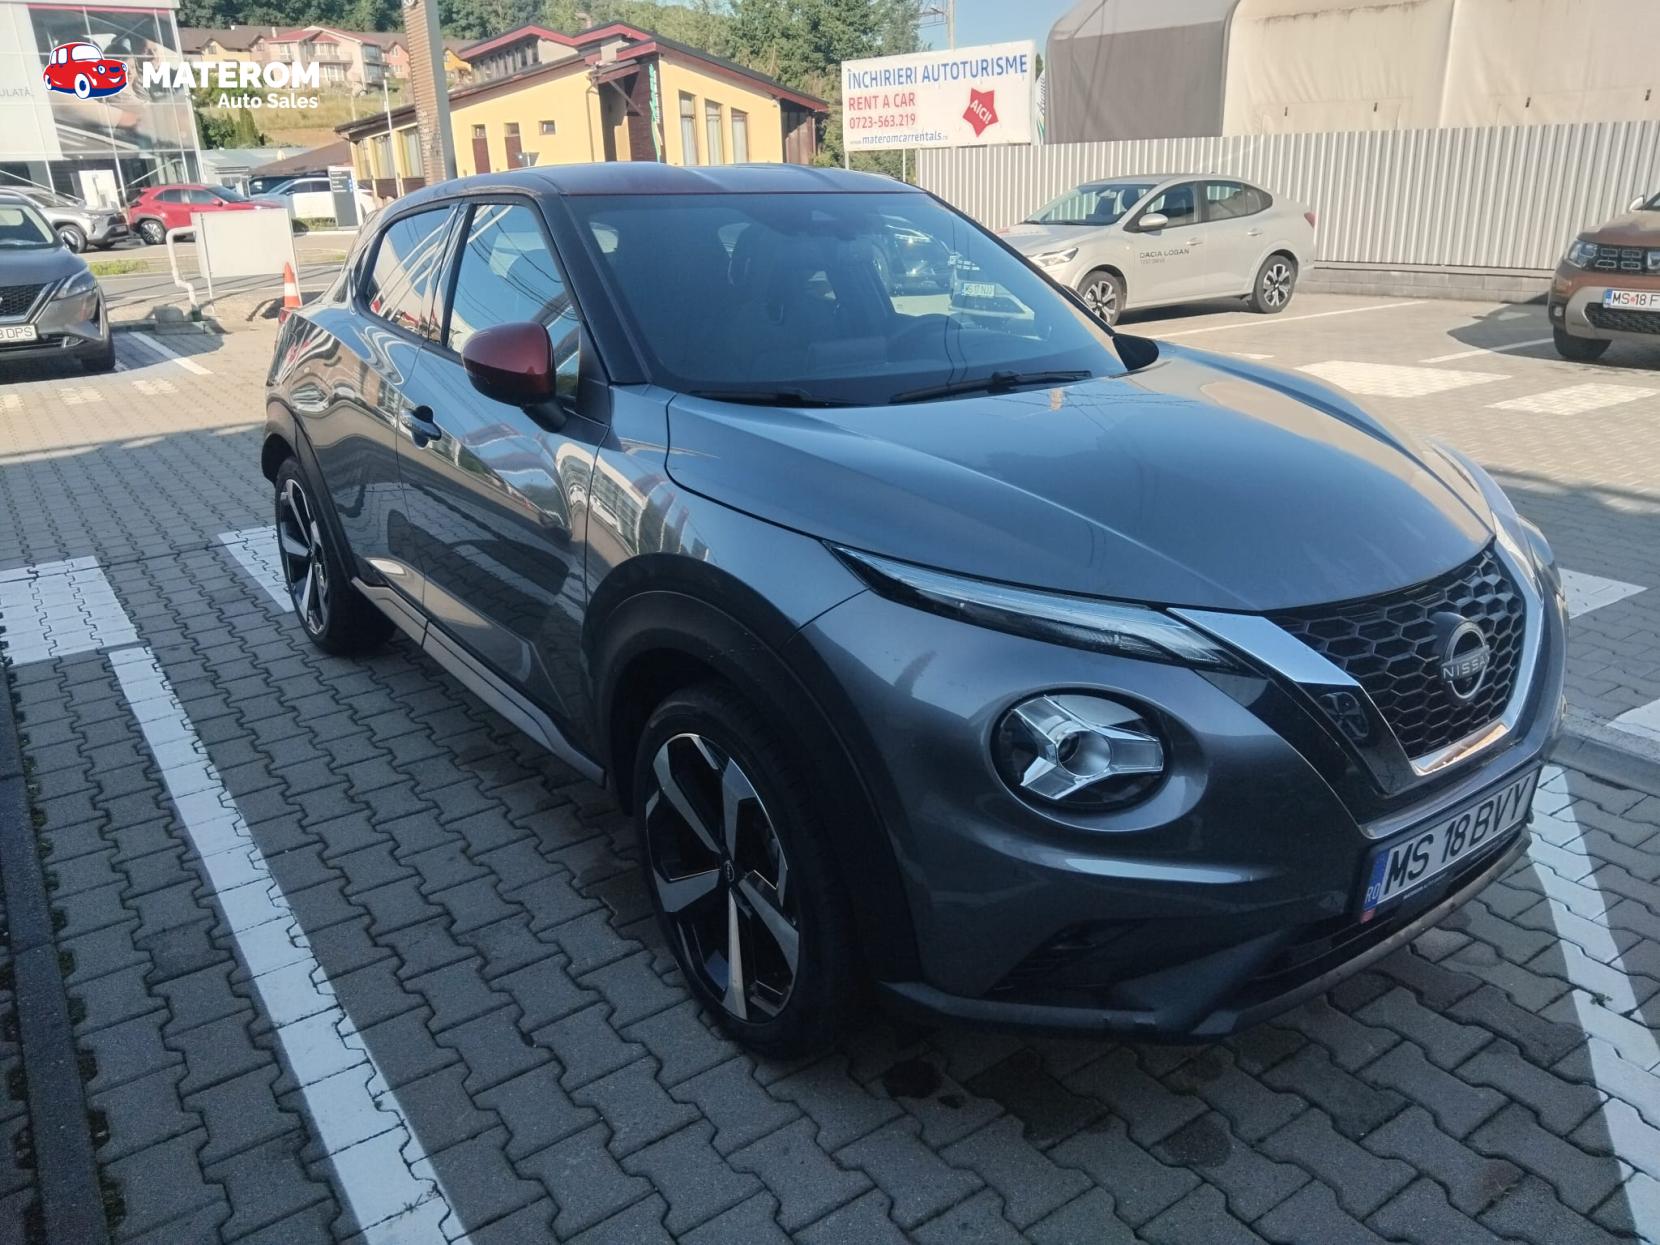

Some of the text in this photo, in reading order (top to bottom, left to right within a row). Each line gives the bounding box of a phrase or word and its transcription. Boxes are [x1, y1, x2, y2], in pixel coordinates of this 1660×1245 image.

[922, 54, 1028, 83] AUTOTURISME
[848, 92, 916, 111] RENT A CAR
[849, 113, 916, 129] 0723-563.219
[970, 99, 992, 125] AICI!
[1163, 248, 1190, 256] LOGAN
[1612, 292, 1631, 305] MS
[1635, 293, 1647, 306] 18
[6, 327, 32, 338] DPS
[1384, 834, 1434, 895] MS
[1364, 882, 1381, 905] RO
